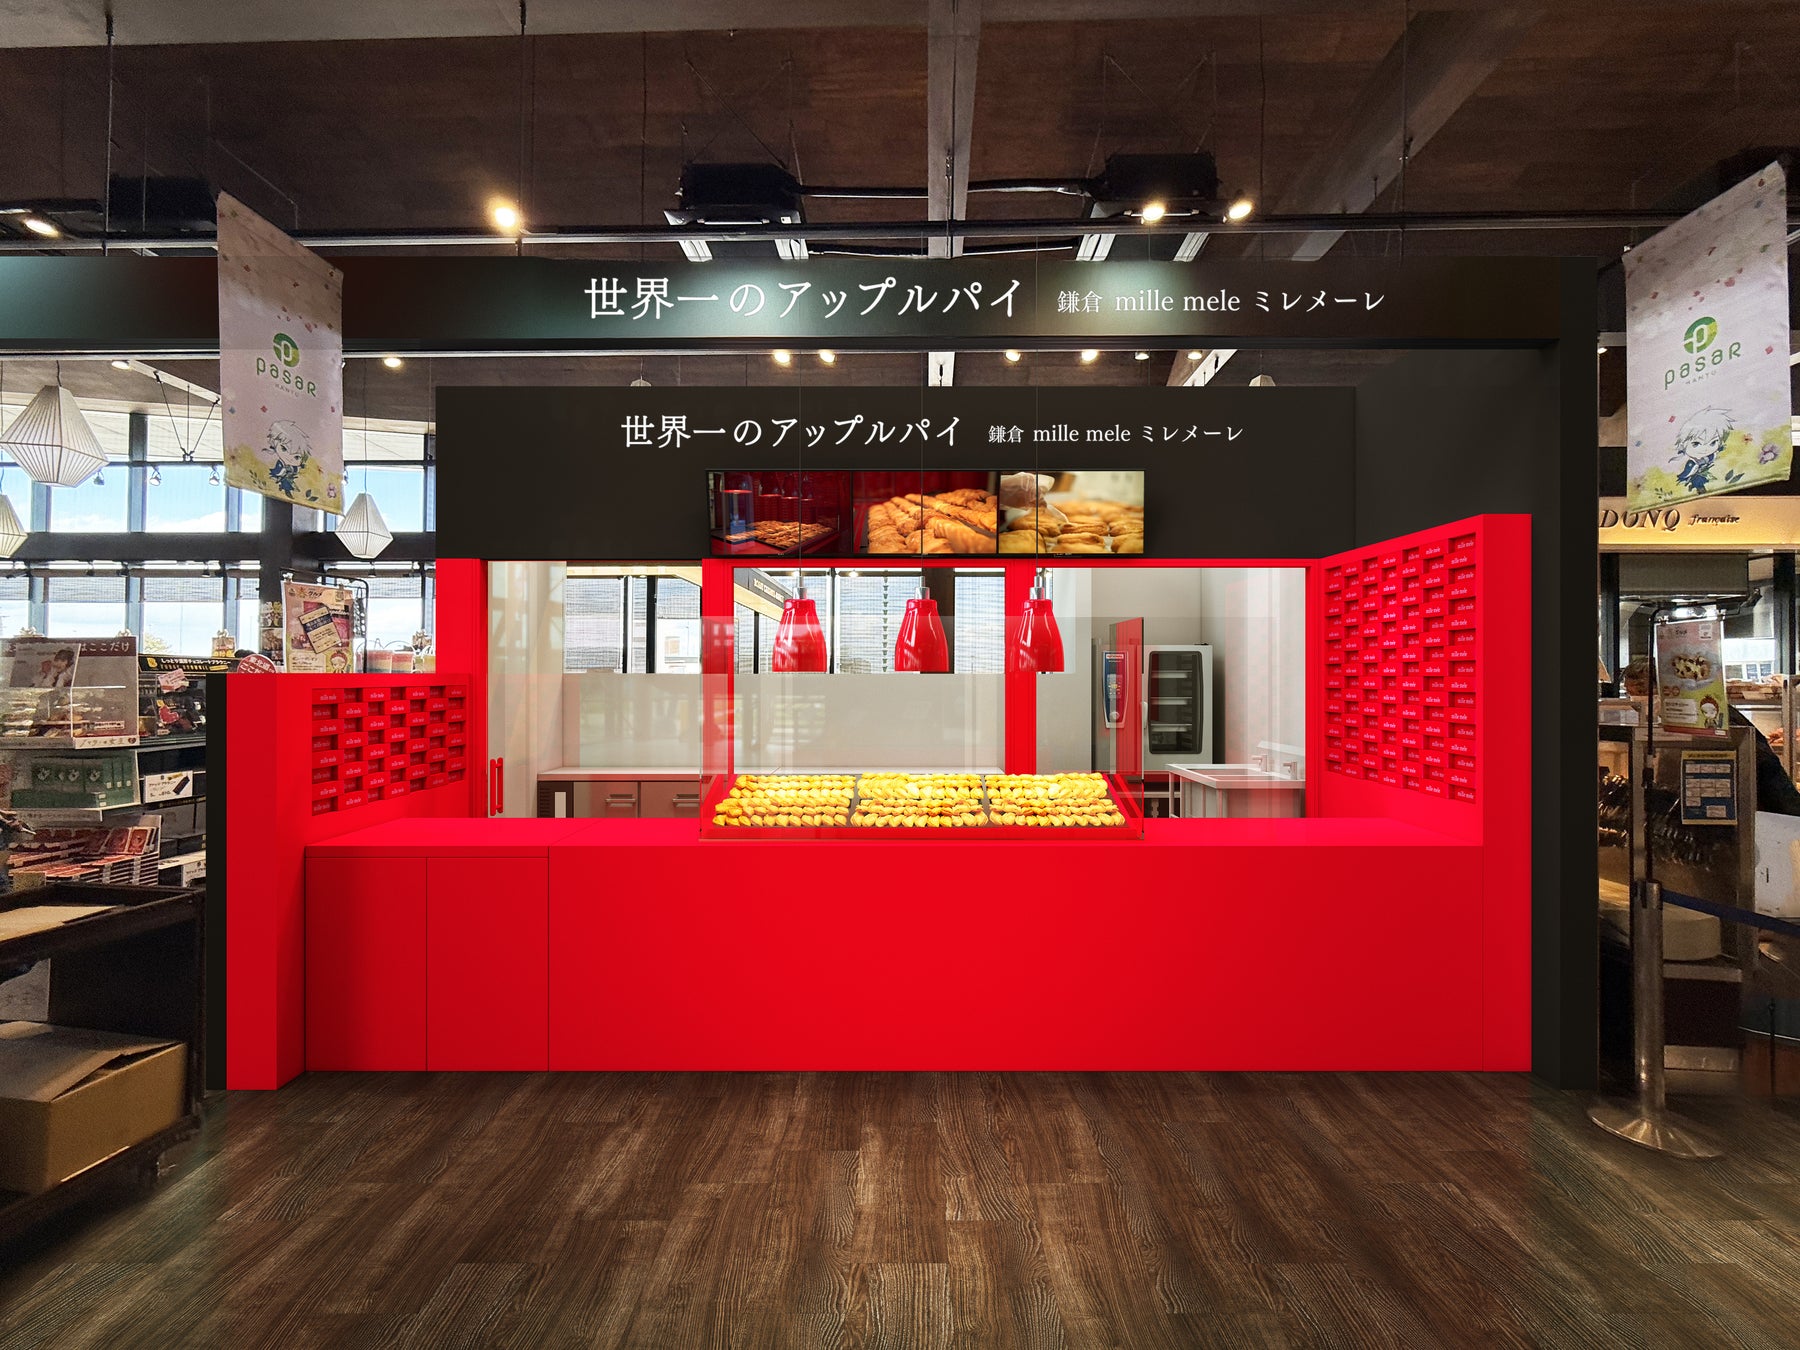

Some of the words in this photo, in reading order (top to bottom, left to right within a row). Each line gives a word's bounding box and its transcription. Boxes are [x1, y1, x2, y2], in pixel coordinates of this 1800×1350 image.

[585, 277, 1020, 319] 世界一のアップルパイ
[1057, 290, 1102, 313] 鎌倉
[1115, 289, 1174, 311] mille
[1184, 289, 1240, 311] mele
[1255, 291, 1384, 312] ミレメーレ
[620, 415, 960, 448] 世界一のアップルパイ
[988, 425, 1024, 443] 鎌倉
[1033, 424, 1079, 442] mille
[1086, 424, 1131, 442] mele
[1142, 425, 1243, 442] ミレメーレ
[1600, 509, 1681, 531] DONQ
